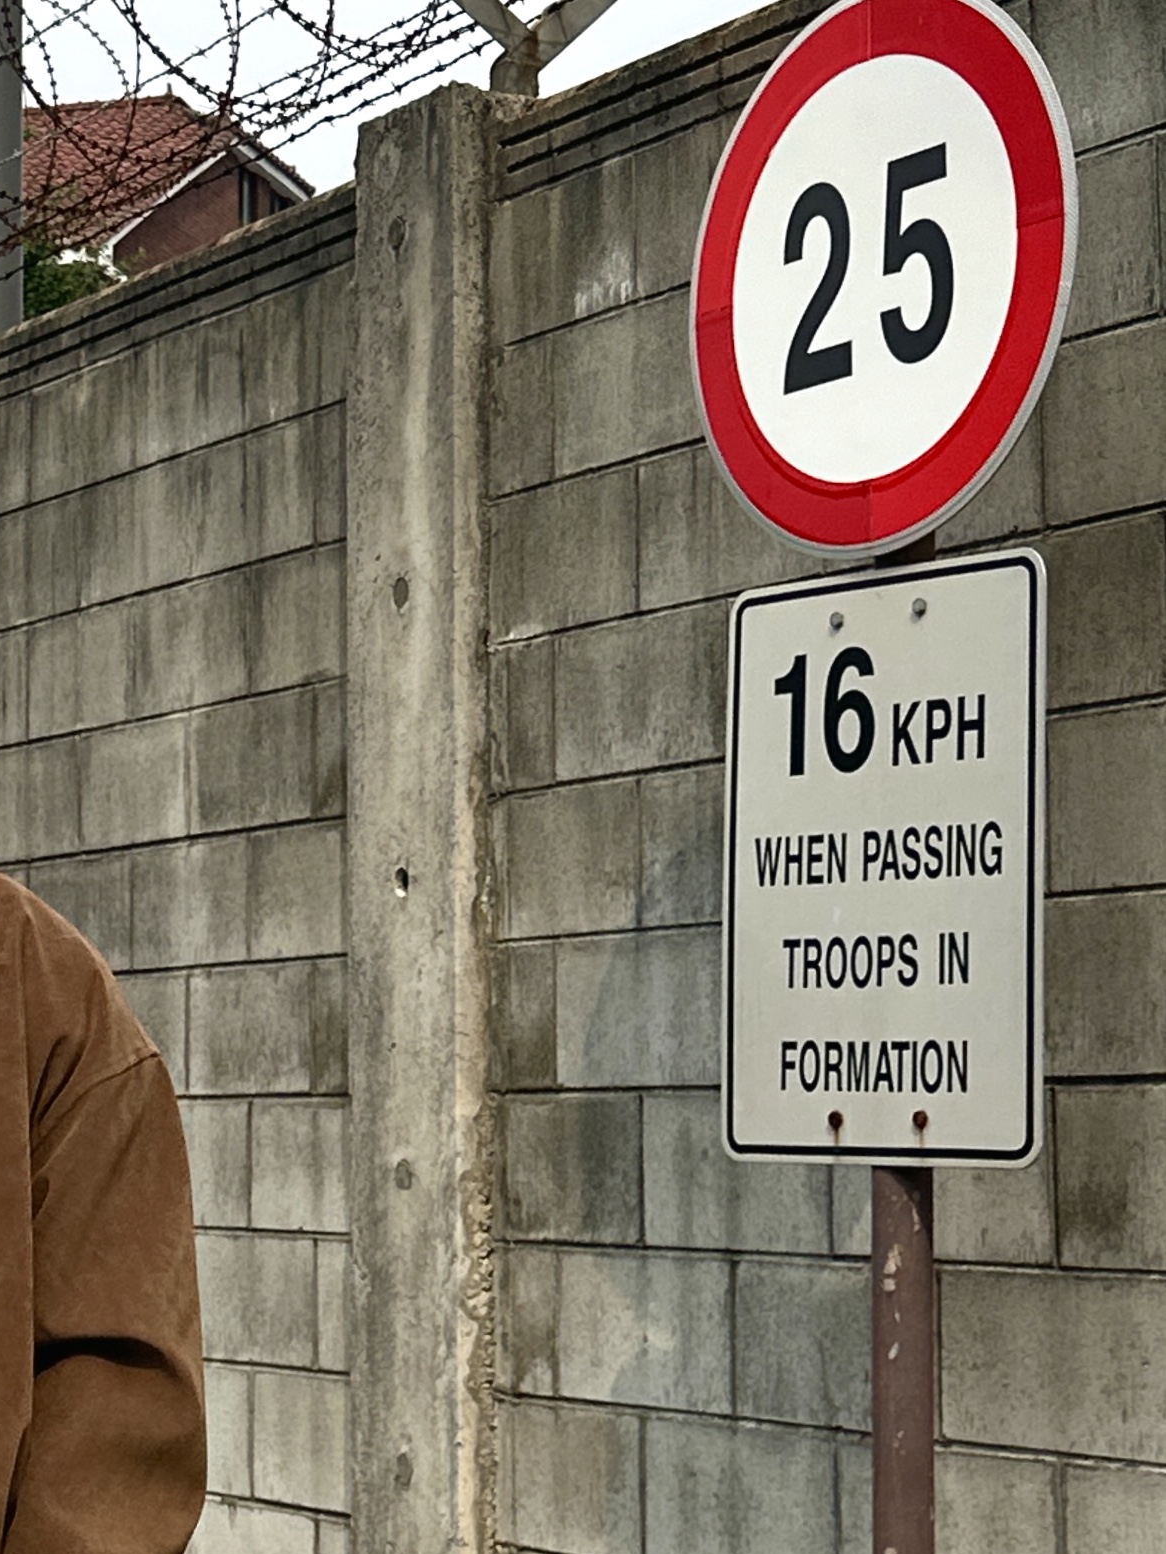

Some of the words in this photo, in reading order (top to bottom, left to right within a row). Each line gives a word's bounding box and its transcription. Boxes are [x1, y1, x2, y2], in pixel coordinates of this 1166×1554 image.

[783, 141, 955, 396] 25
[774, 646, 876, 777] 16
[891, 693, 986, 767] KPH
[754, 832, 848, 887] WHEN
[862, 820, 1003, 882] PASSING
[782, 933, 919, 990] TROOPS
[938, 931, 969, 985] IN
[780, 1039, 968, 1094] FORMATION
